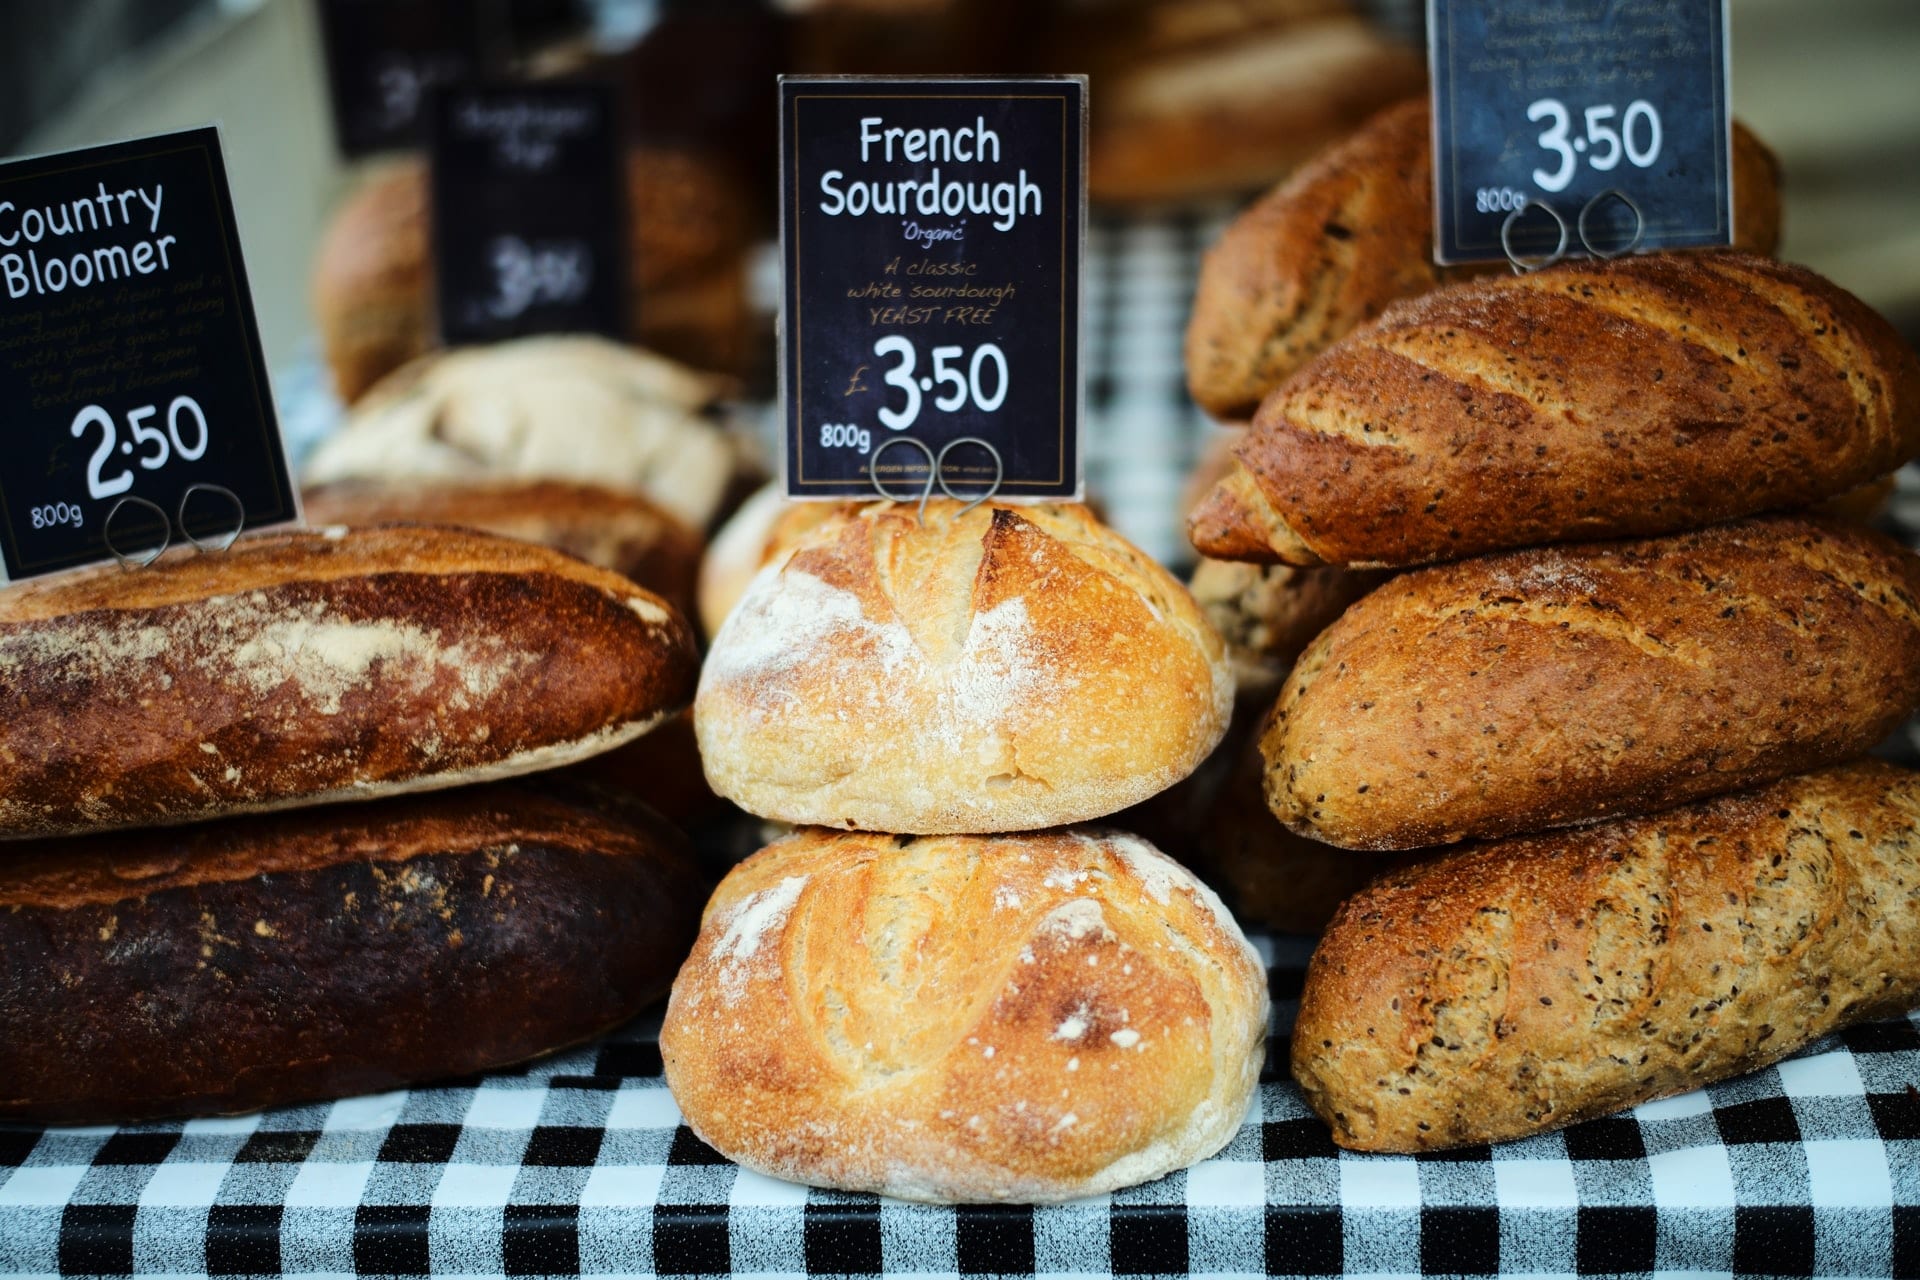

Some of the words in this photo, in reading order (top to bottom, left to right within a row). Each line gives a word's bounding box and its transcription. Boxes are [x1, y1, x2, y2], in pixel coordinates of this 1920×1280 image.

[859, 115, 1000, 163] French
[0, 182, 163, 247] Country
[819, 167, 1042, 232] Sourdough
[0, 235, 177, 299] Bloomer
[884, 256, 898, 276] A
[905, 257, 978, 276] classic
[847, 281, 903, 299] white
[908, 282, 1017, 308] sourdough
[870, 306, 941, 326] YEAST
[943, 306, 996, 325] FREE
[844, 365, 870, 397] £
[820, 423, 871, 454] 800g
[31, 501, 84, 529] 800g
